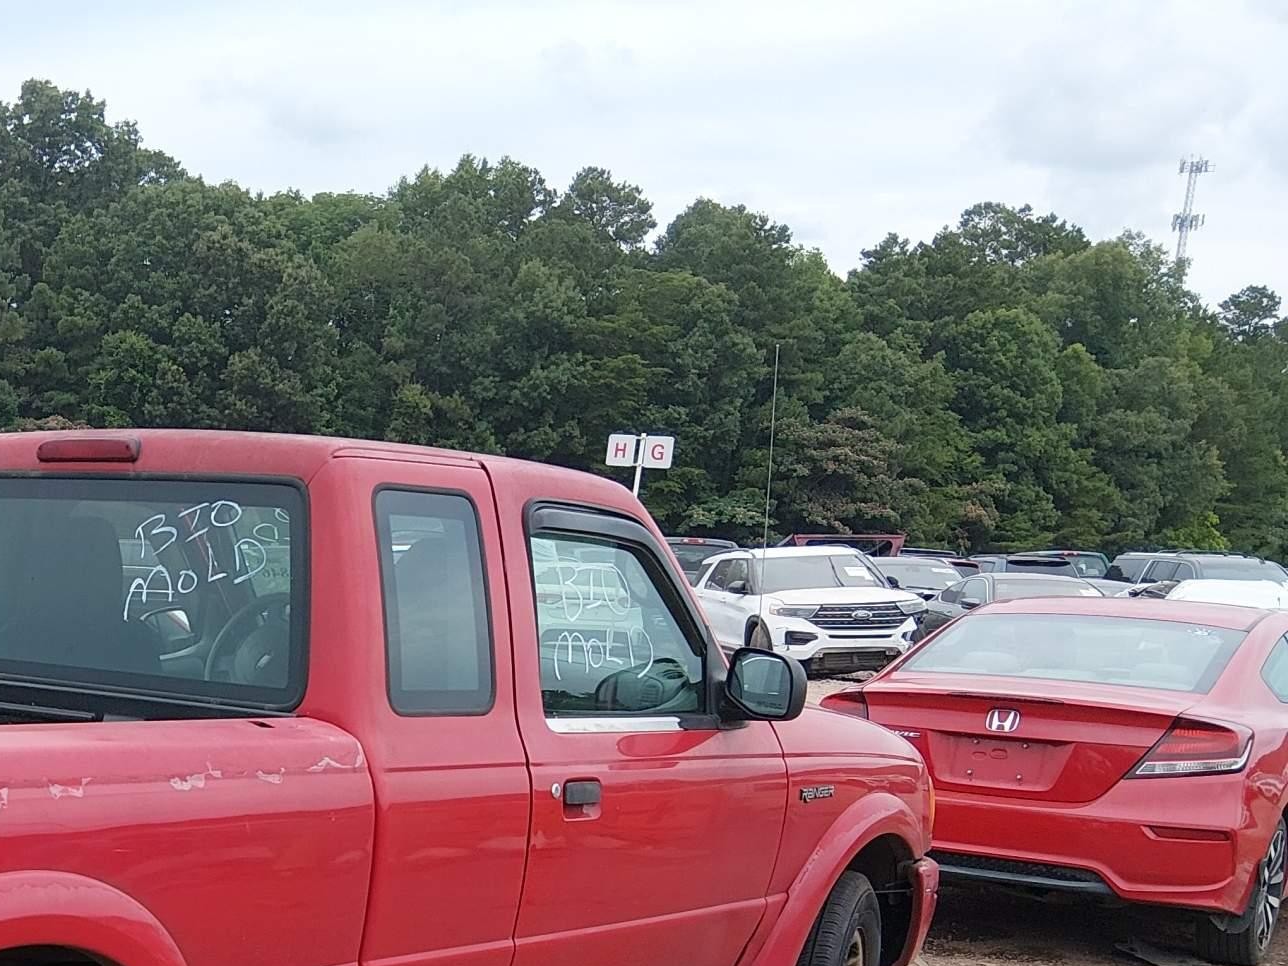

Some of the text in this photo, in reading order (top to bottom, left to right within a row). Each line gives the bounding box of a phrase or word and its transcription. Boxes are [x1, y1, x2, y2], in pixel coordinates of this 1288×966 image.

[614, 442, 627, 459] H
[651, 443, 665, 460] G
[134, 500, 242, 559] BIO
[123, 533, 267, 622] MOLD
[554, 625, 654, 681] MOLD
[799, 785, 835, 803] RANGER
